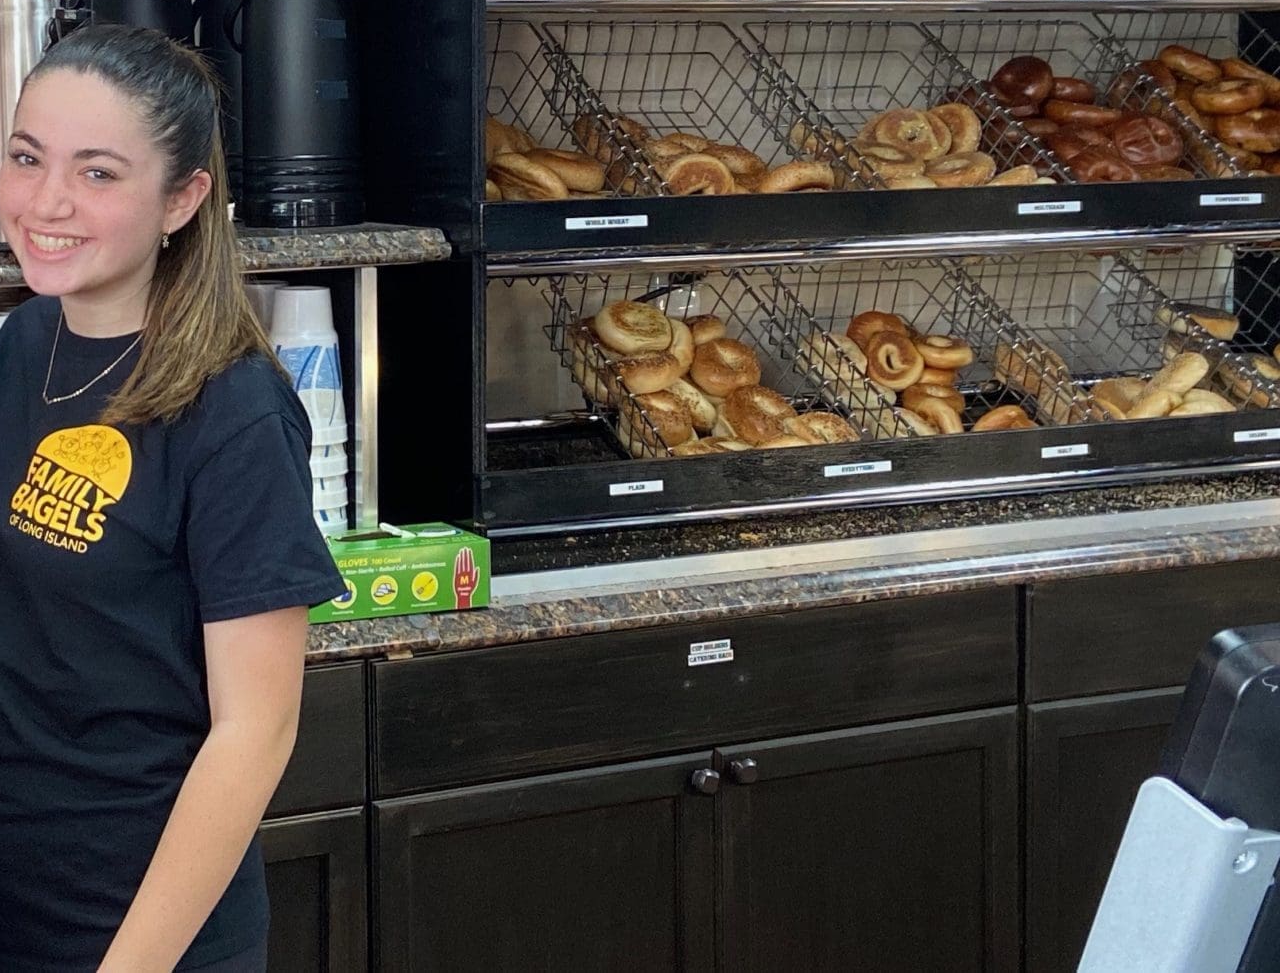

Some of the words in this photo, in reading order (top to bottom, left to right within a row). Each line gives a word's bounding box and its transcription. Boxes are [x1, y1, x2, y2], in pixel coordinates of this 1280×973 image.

[607, 218, 630, 226] WHEAT
[26, 455, 117, 512] FAMILY
[10, 482, 107, 542] BAGELS
[9, 513, 20, 526] OF
[18, 520, 44, 540] LONG
[44, 530, 88, 554] ISLAND
[337, 557, 369, 569] GLOVES
[460, 576, 469, 585] M
